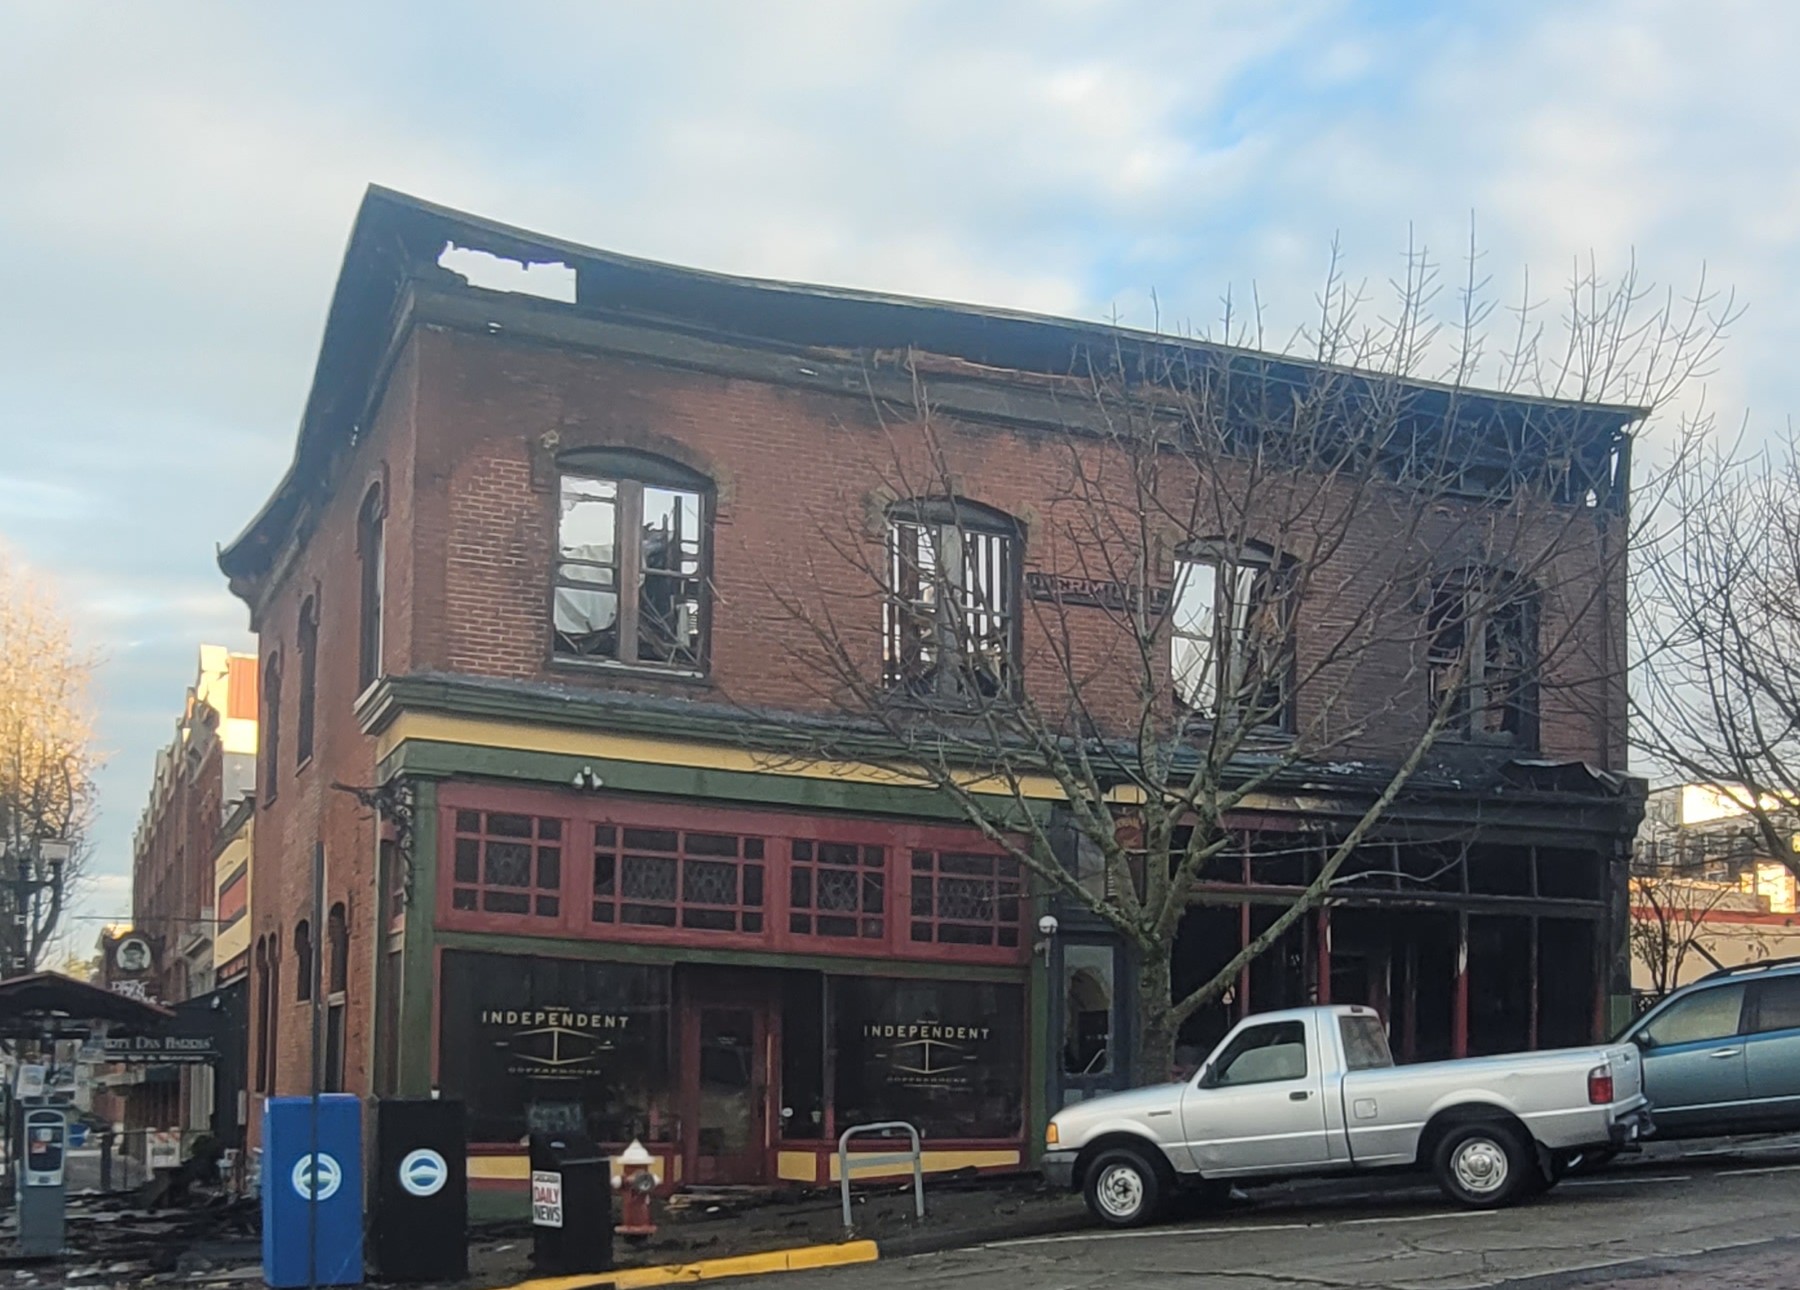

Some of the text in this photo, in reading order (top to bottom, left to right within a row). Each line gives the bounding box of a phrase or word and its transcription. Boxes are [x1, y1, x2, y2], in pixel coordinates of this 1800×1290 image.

[482, 1010, 629, 1029] INDEPENDENT
[863, 1025, 990, 1039] INDEPENDENT
[534, 1186, 560, 1204] DAILY
[534, 1204, 561, 1223] NEWS
